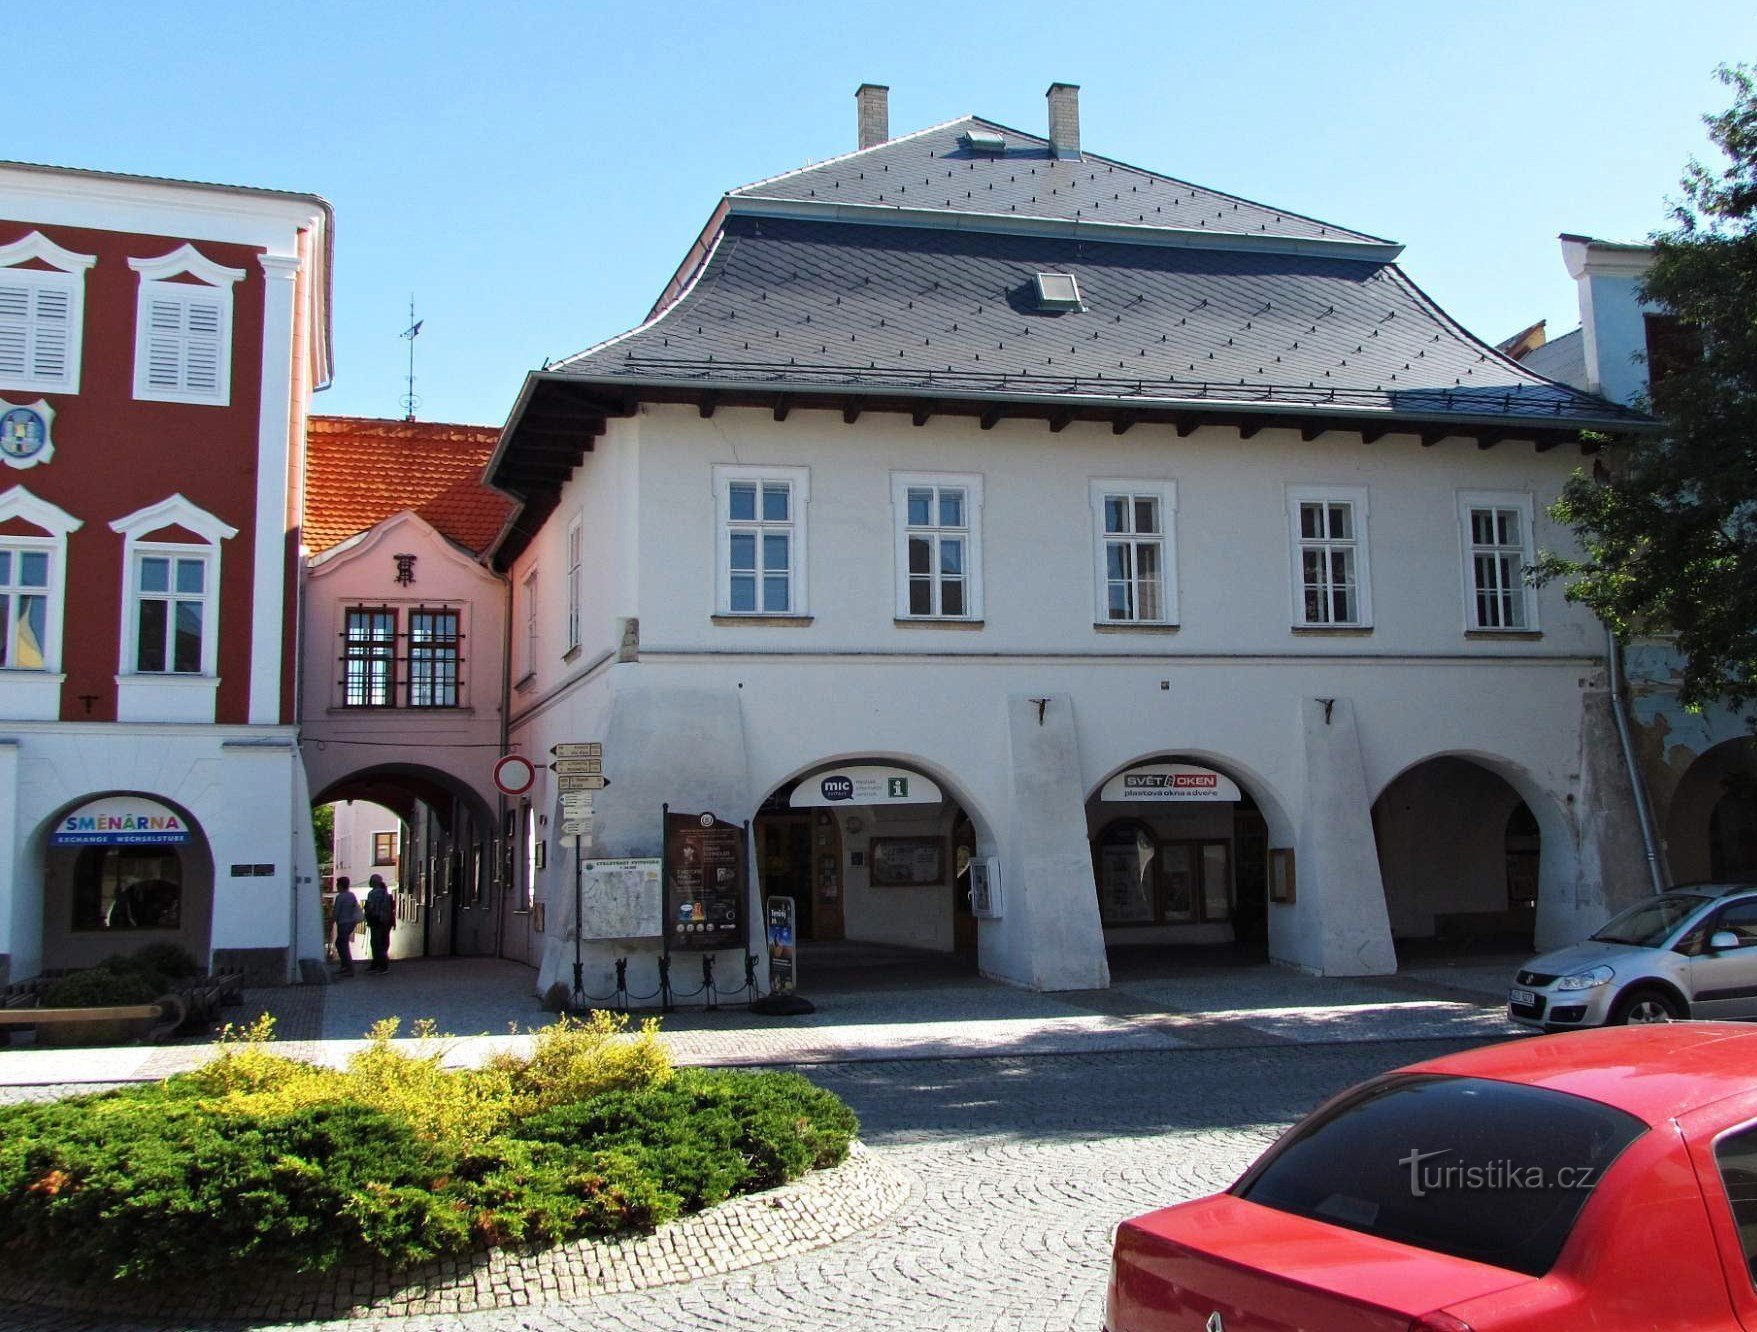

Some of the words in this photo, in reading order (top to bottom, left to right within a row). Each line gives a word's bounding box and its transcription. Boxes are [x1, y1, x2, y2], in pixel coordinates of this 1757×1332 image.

[1127, 775, 1162, 786] SVĚT
[1176, 777, 1215, 786] OKEN
[824, 782, 850, 791] mic
[1125, 789, 1162, 797] plastová
[66, 813, 179, 831] SMĚNÁRNA
